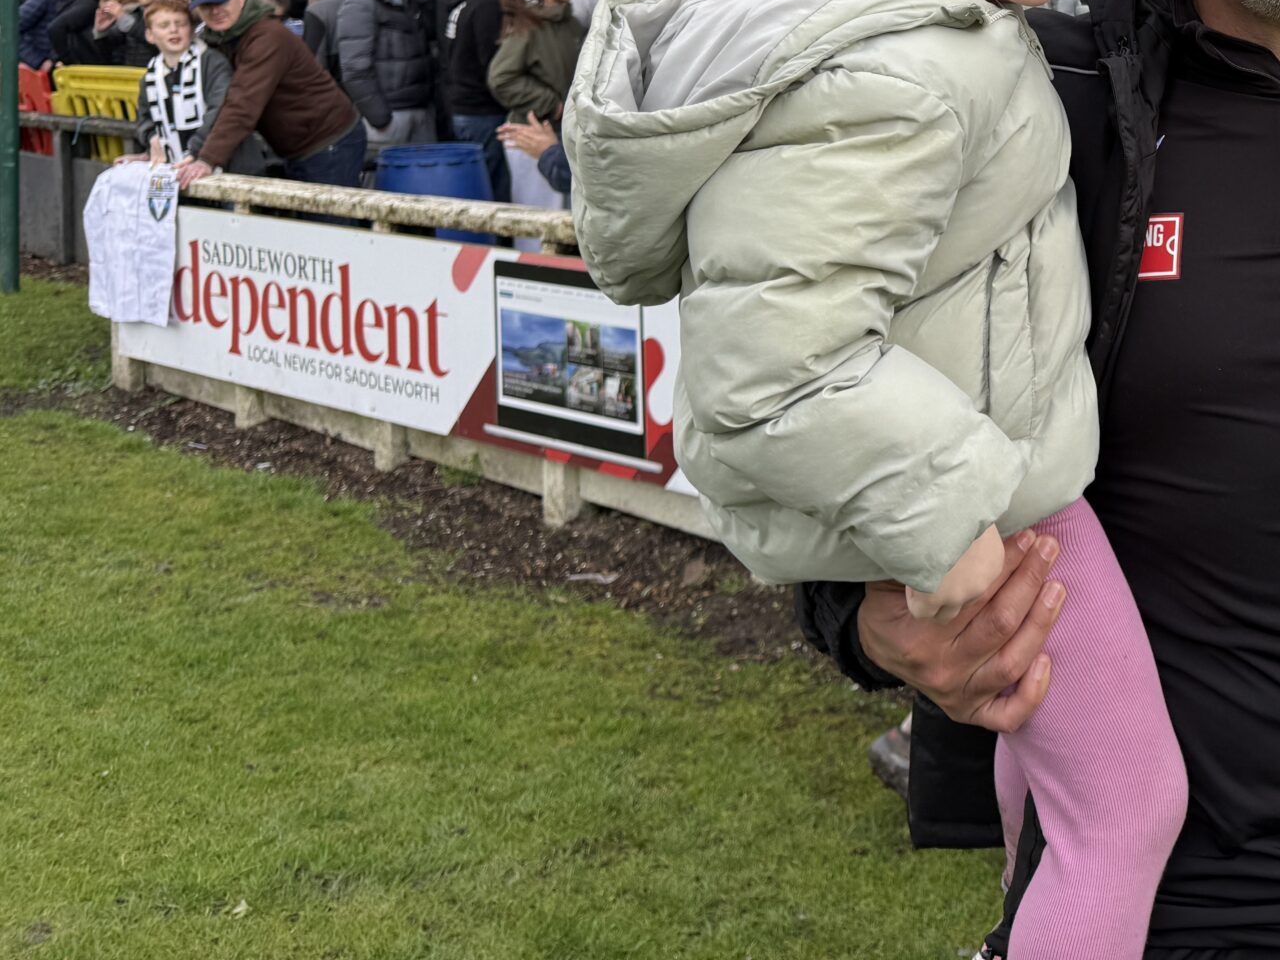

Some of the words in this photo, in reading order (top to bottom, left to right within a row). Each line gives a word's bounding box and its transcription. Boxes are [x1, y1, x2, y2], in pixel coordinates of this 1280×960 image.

[202, 239, 335, 285] SADDLEWORTH
[171, 239, 449, 378] dependent
[247, 344, 281, 368] LOCAL
[284, 354, 317, 376] NEWS
[319, 361, 343, 381] FOR
[344, 366, 441, 404] SADDLEWORTH
